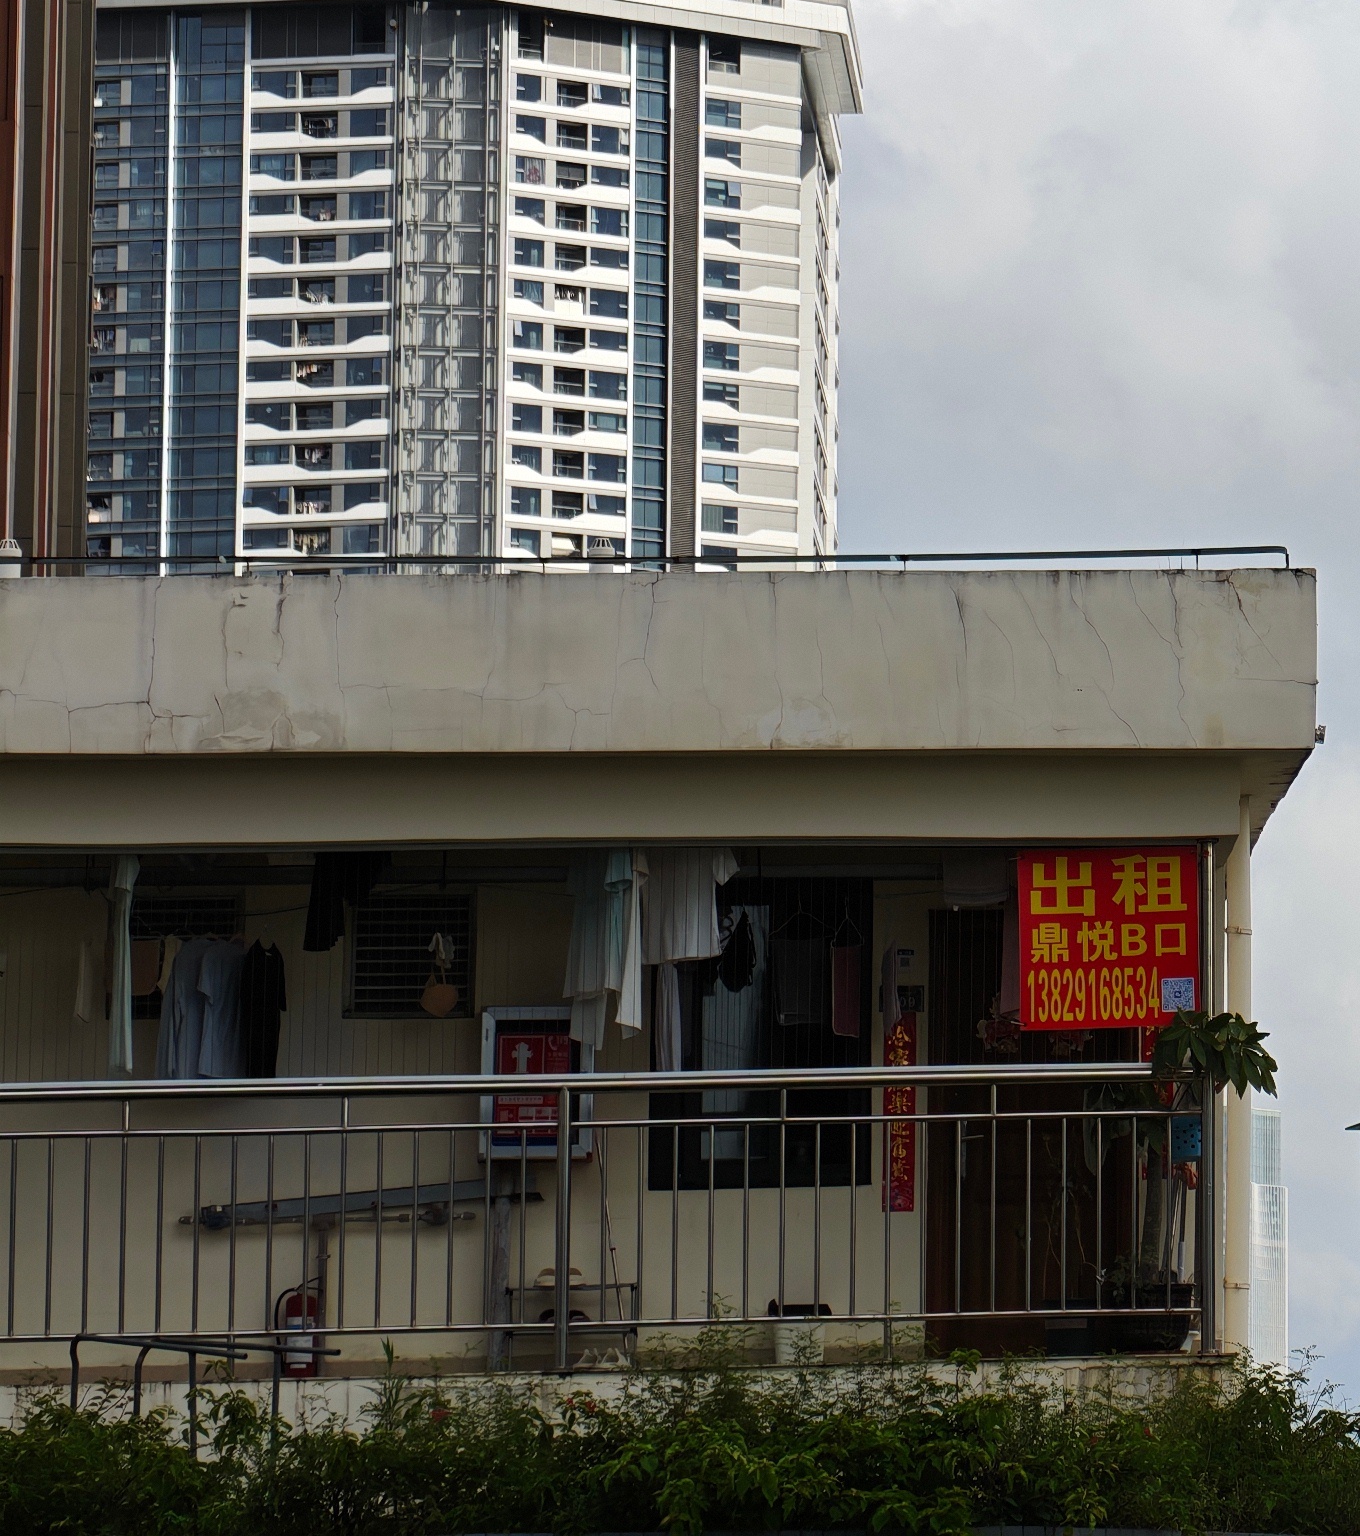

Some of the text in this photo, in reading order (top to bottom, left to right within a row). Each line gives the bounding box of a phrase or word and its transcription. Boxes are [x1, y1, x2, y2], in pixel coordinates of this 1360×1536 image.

[1029, 854, 1188, 917] 出租
[1030, 920, 1188, 964] 鼎悦B口
[1027, 965, 1161, 1023] 13829168534
